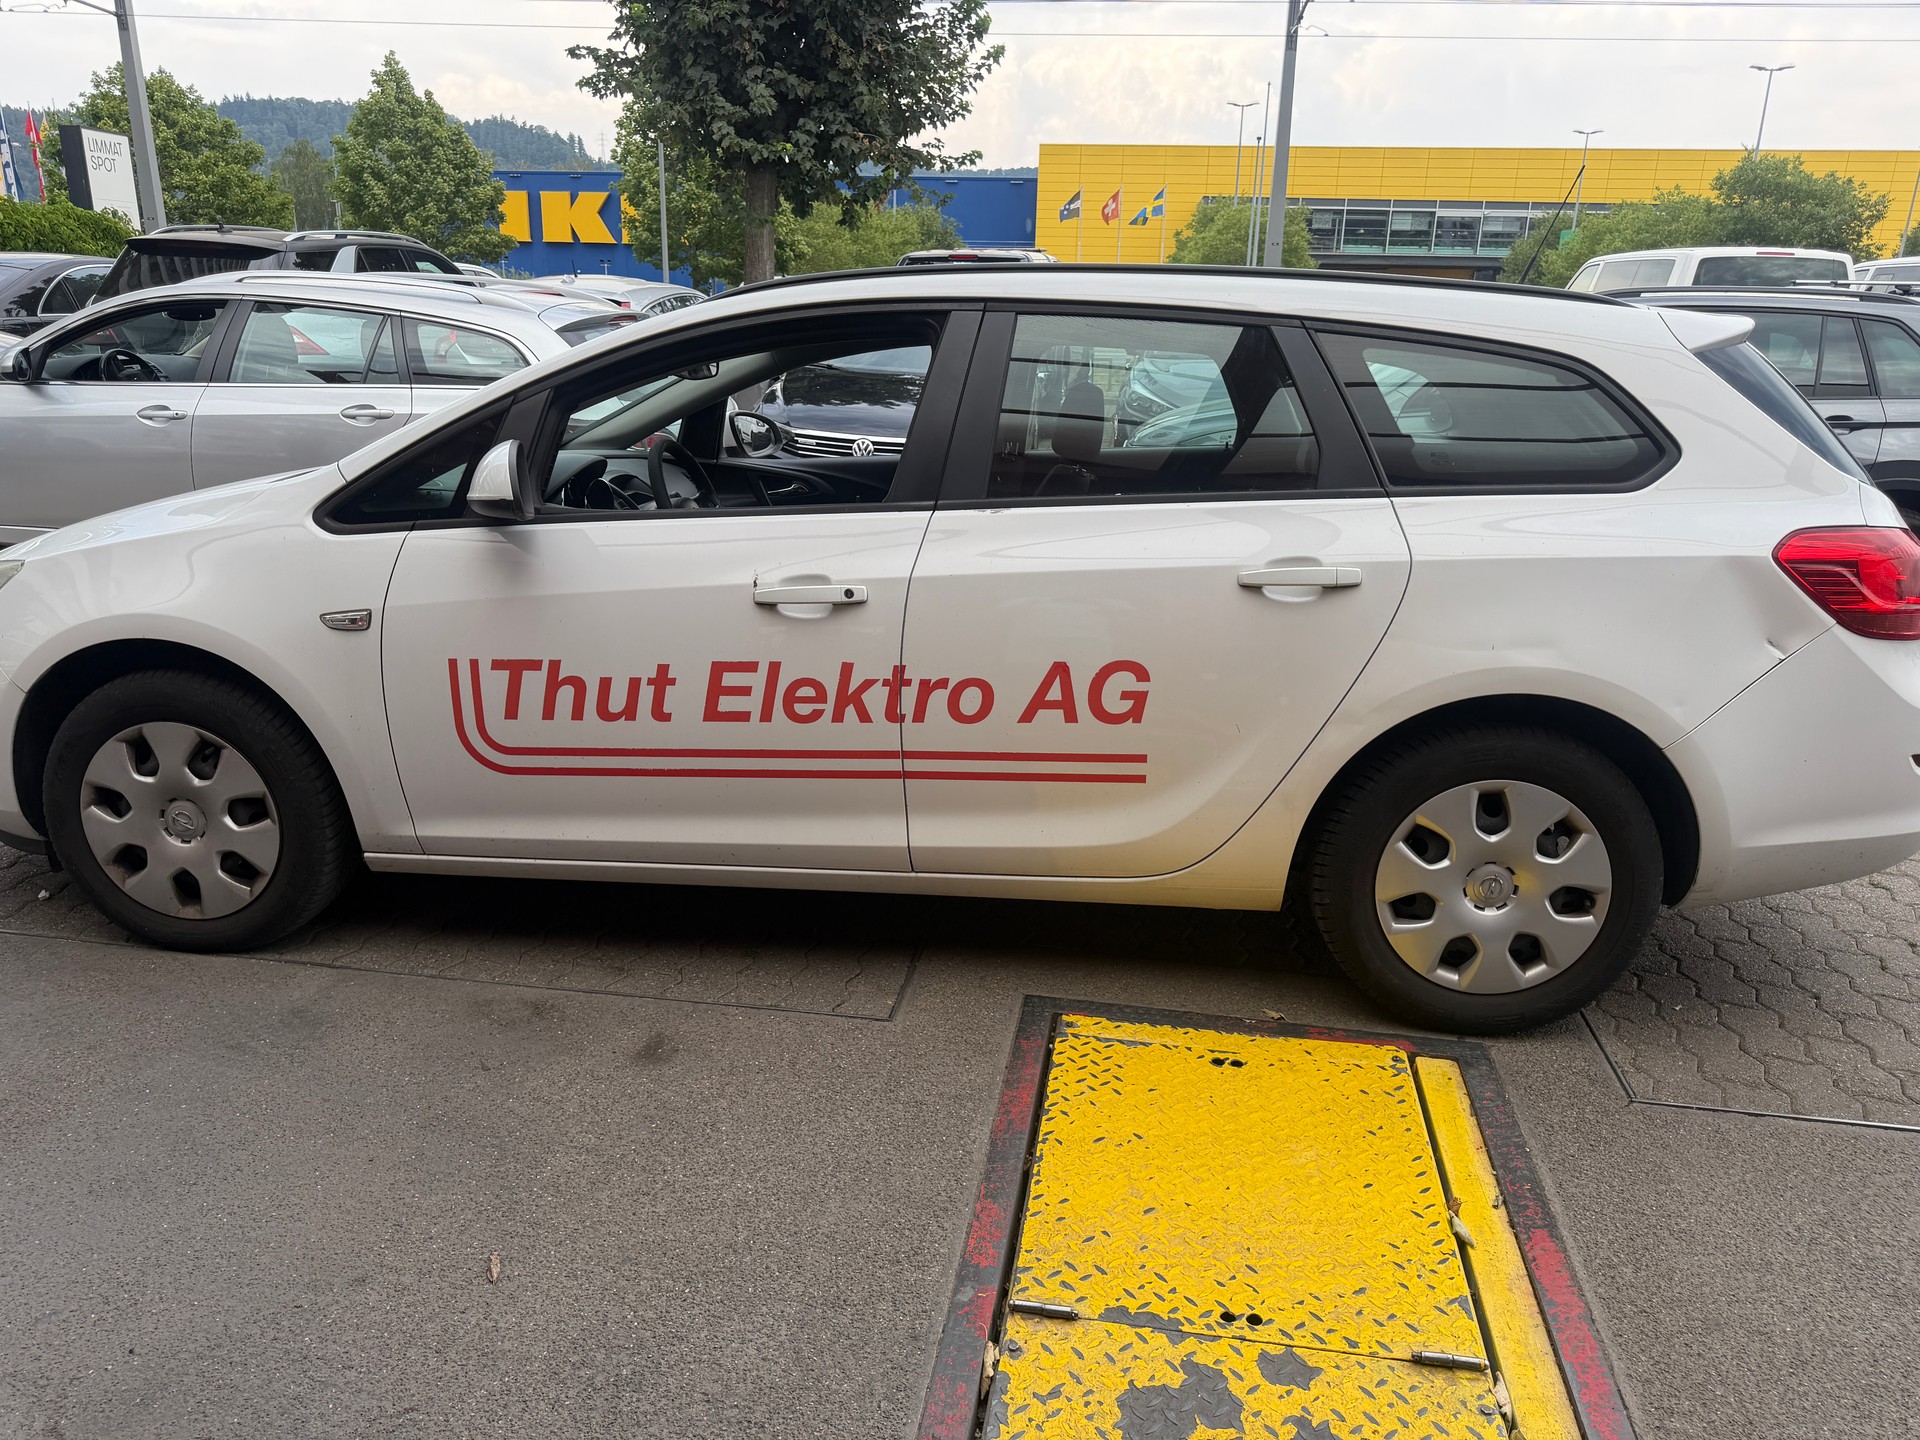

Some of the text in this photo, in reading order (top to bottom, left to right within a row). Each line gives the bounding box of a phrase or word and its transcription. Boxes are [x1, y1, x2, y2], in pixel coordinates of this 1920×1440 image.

[87, 137, 122, 157] LIMMAT
[91, 155, 117, 173] SPOT
[490, 659, 1151, 725] Thut Elektro AG
